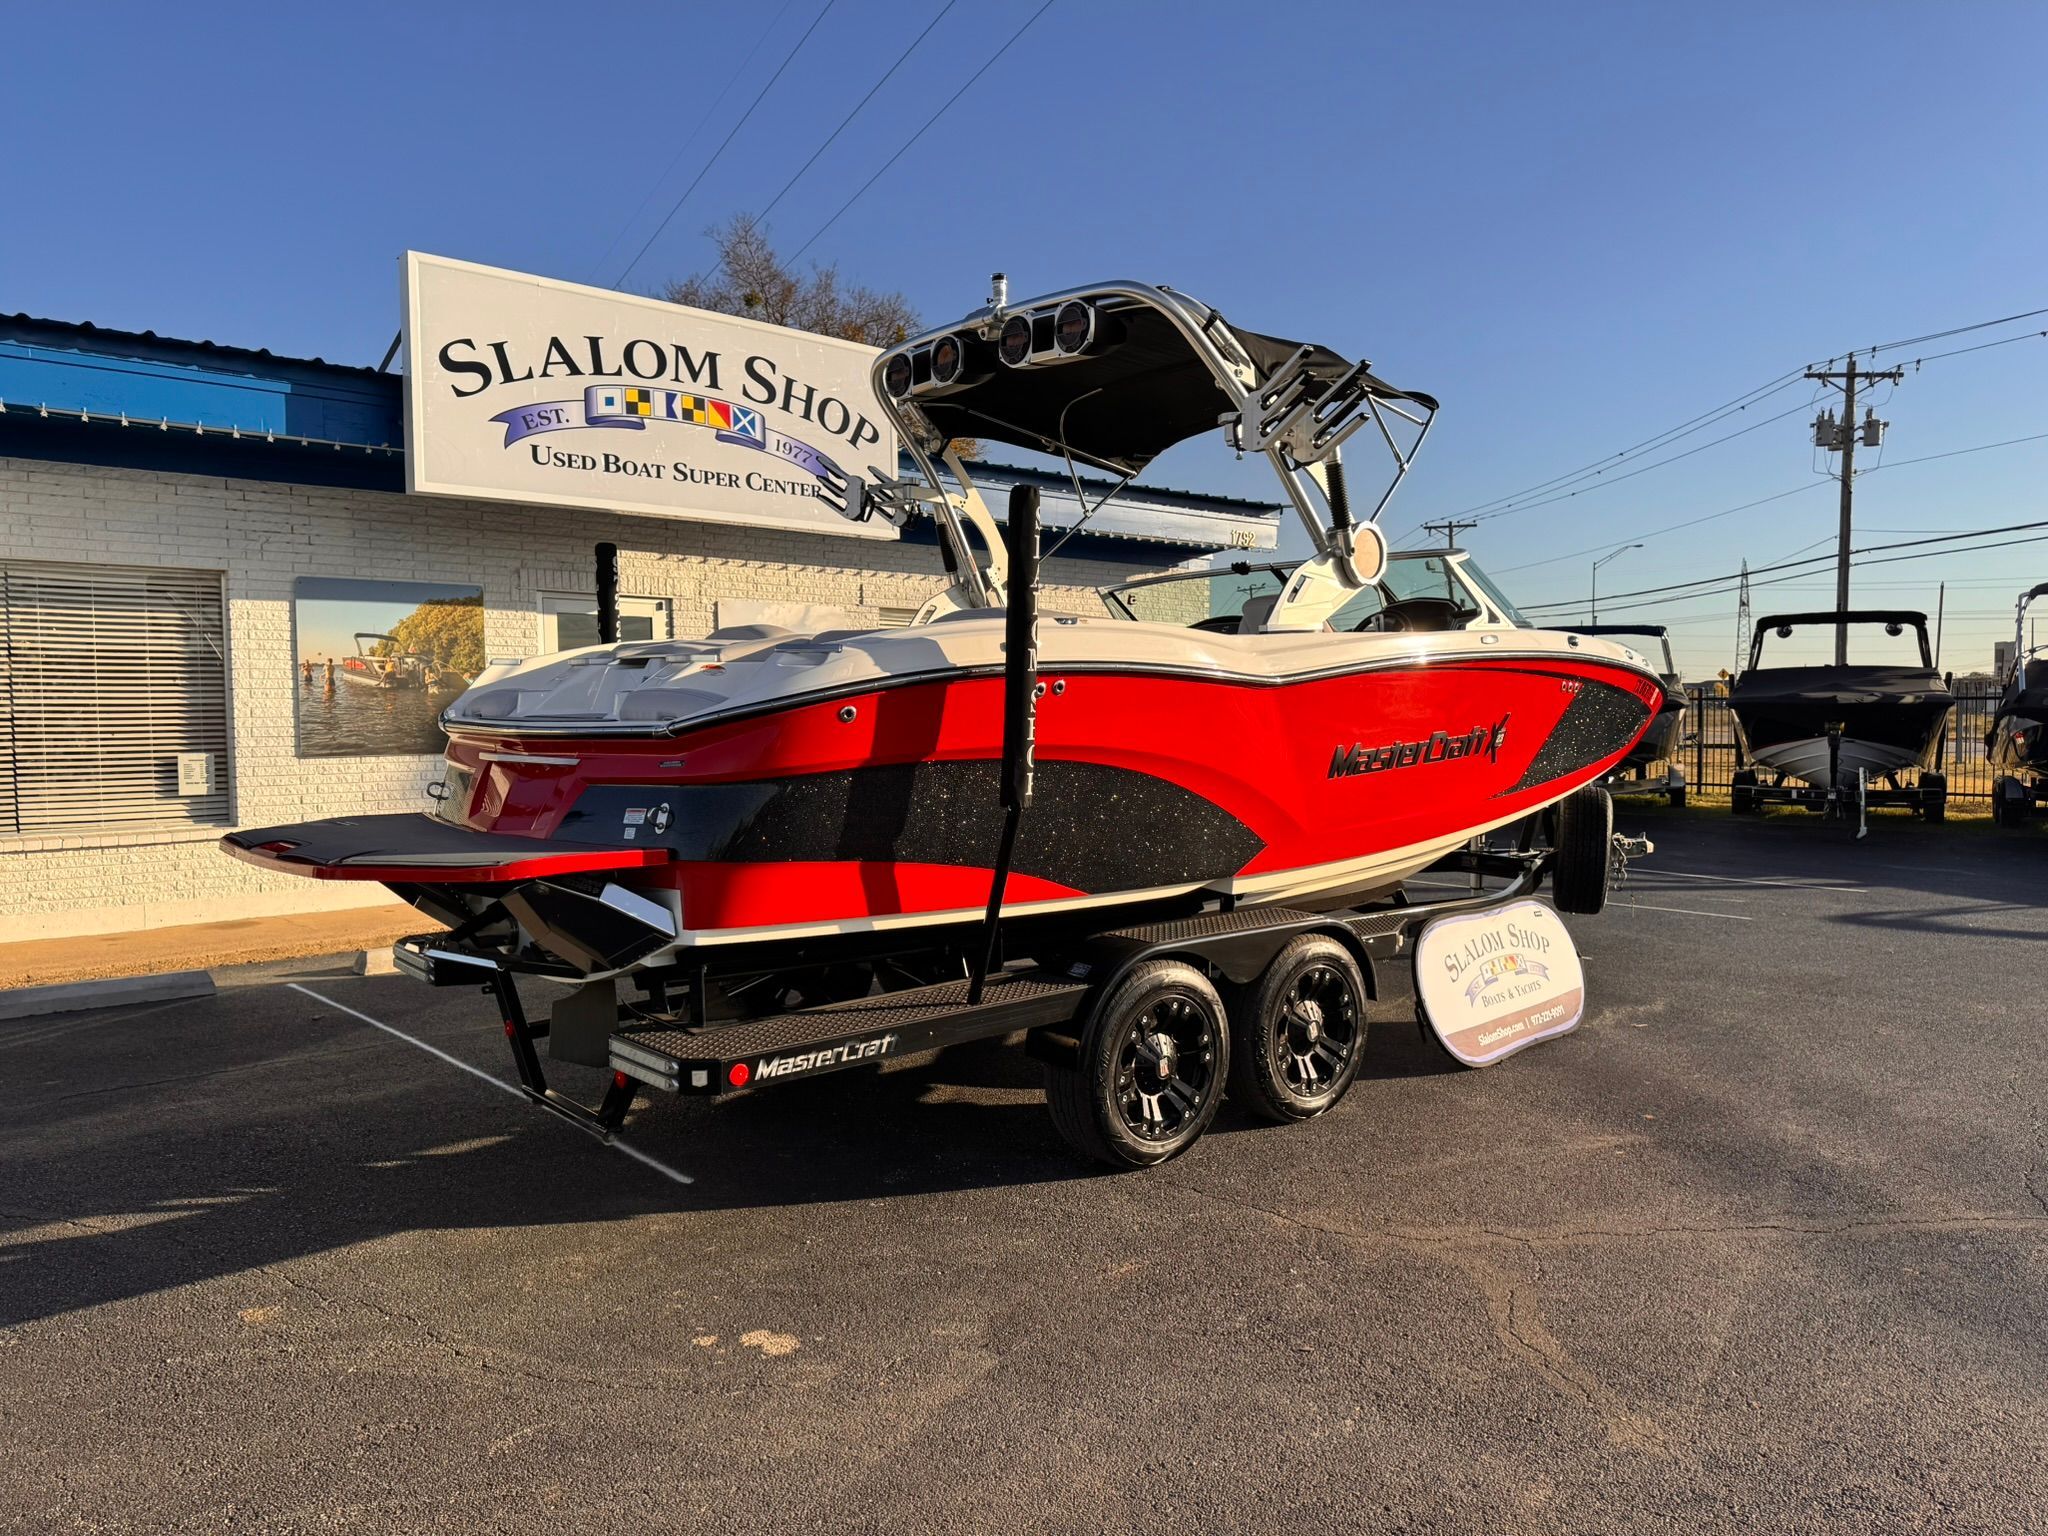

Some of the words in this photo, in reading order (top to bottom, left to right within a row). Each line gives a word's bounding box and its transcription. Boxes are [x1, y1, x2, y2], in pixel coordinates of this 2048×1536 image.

[438, 336, 723, 398] SLALOM
[742, 356, 880, 450] SHOP
[520, 407, 570, 431] EST.
[530, 444, 597, 471] USED
[602, 452, 666, 480] BOAT
[673, 462, 741, 489] SUPER
[745, 472, 821, 498] CENTER
[775, 438, 813, 463] 1977
[1230, 529, 1256, 547] 1792
[1327, 724, 1488, 779] MasterCraft
[1444, 931, 1504, 982] SLALOM
[1508, 923, 1549, 953] SHOP
[1481, 991, 1506, 1008] BOATS
[754, 1033, 899, 1081] MasterCraft
